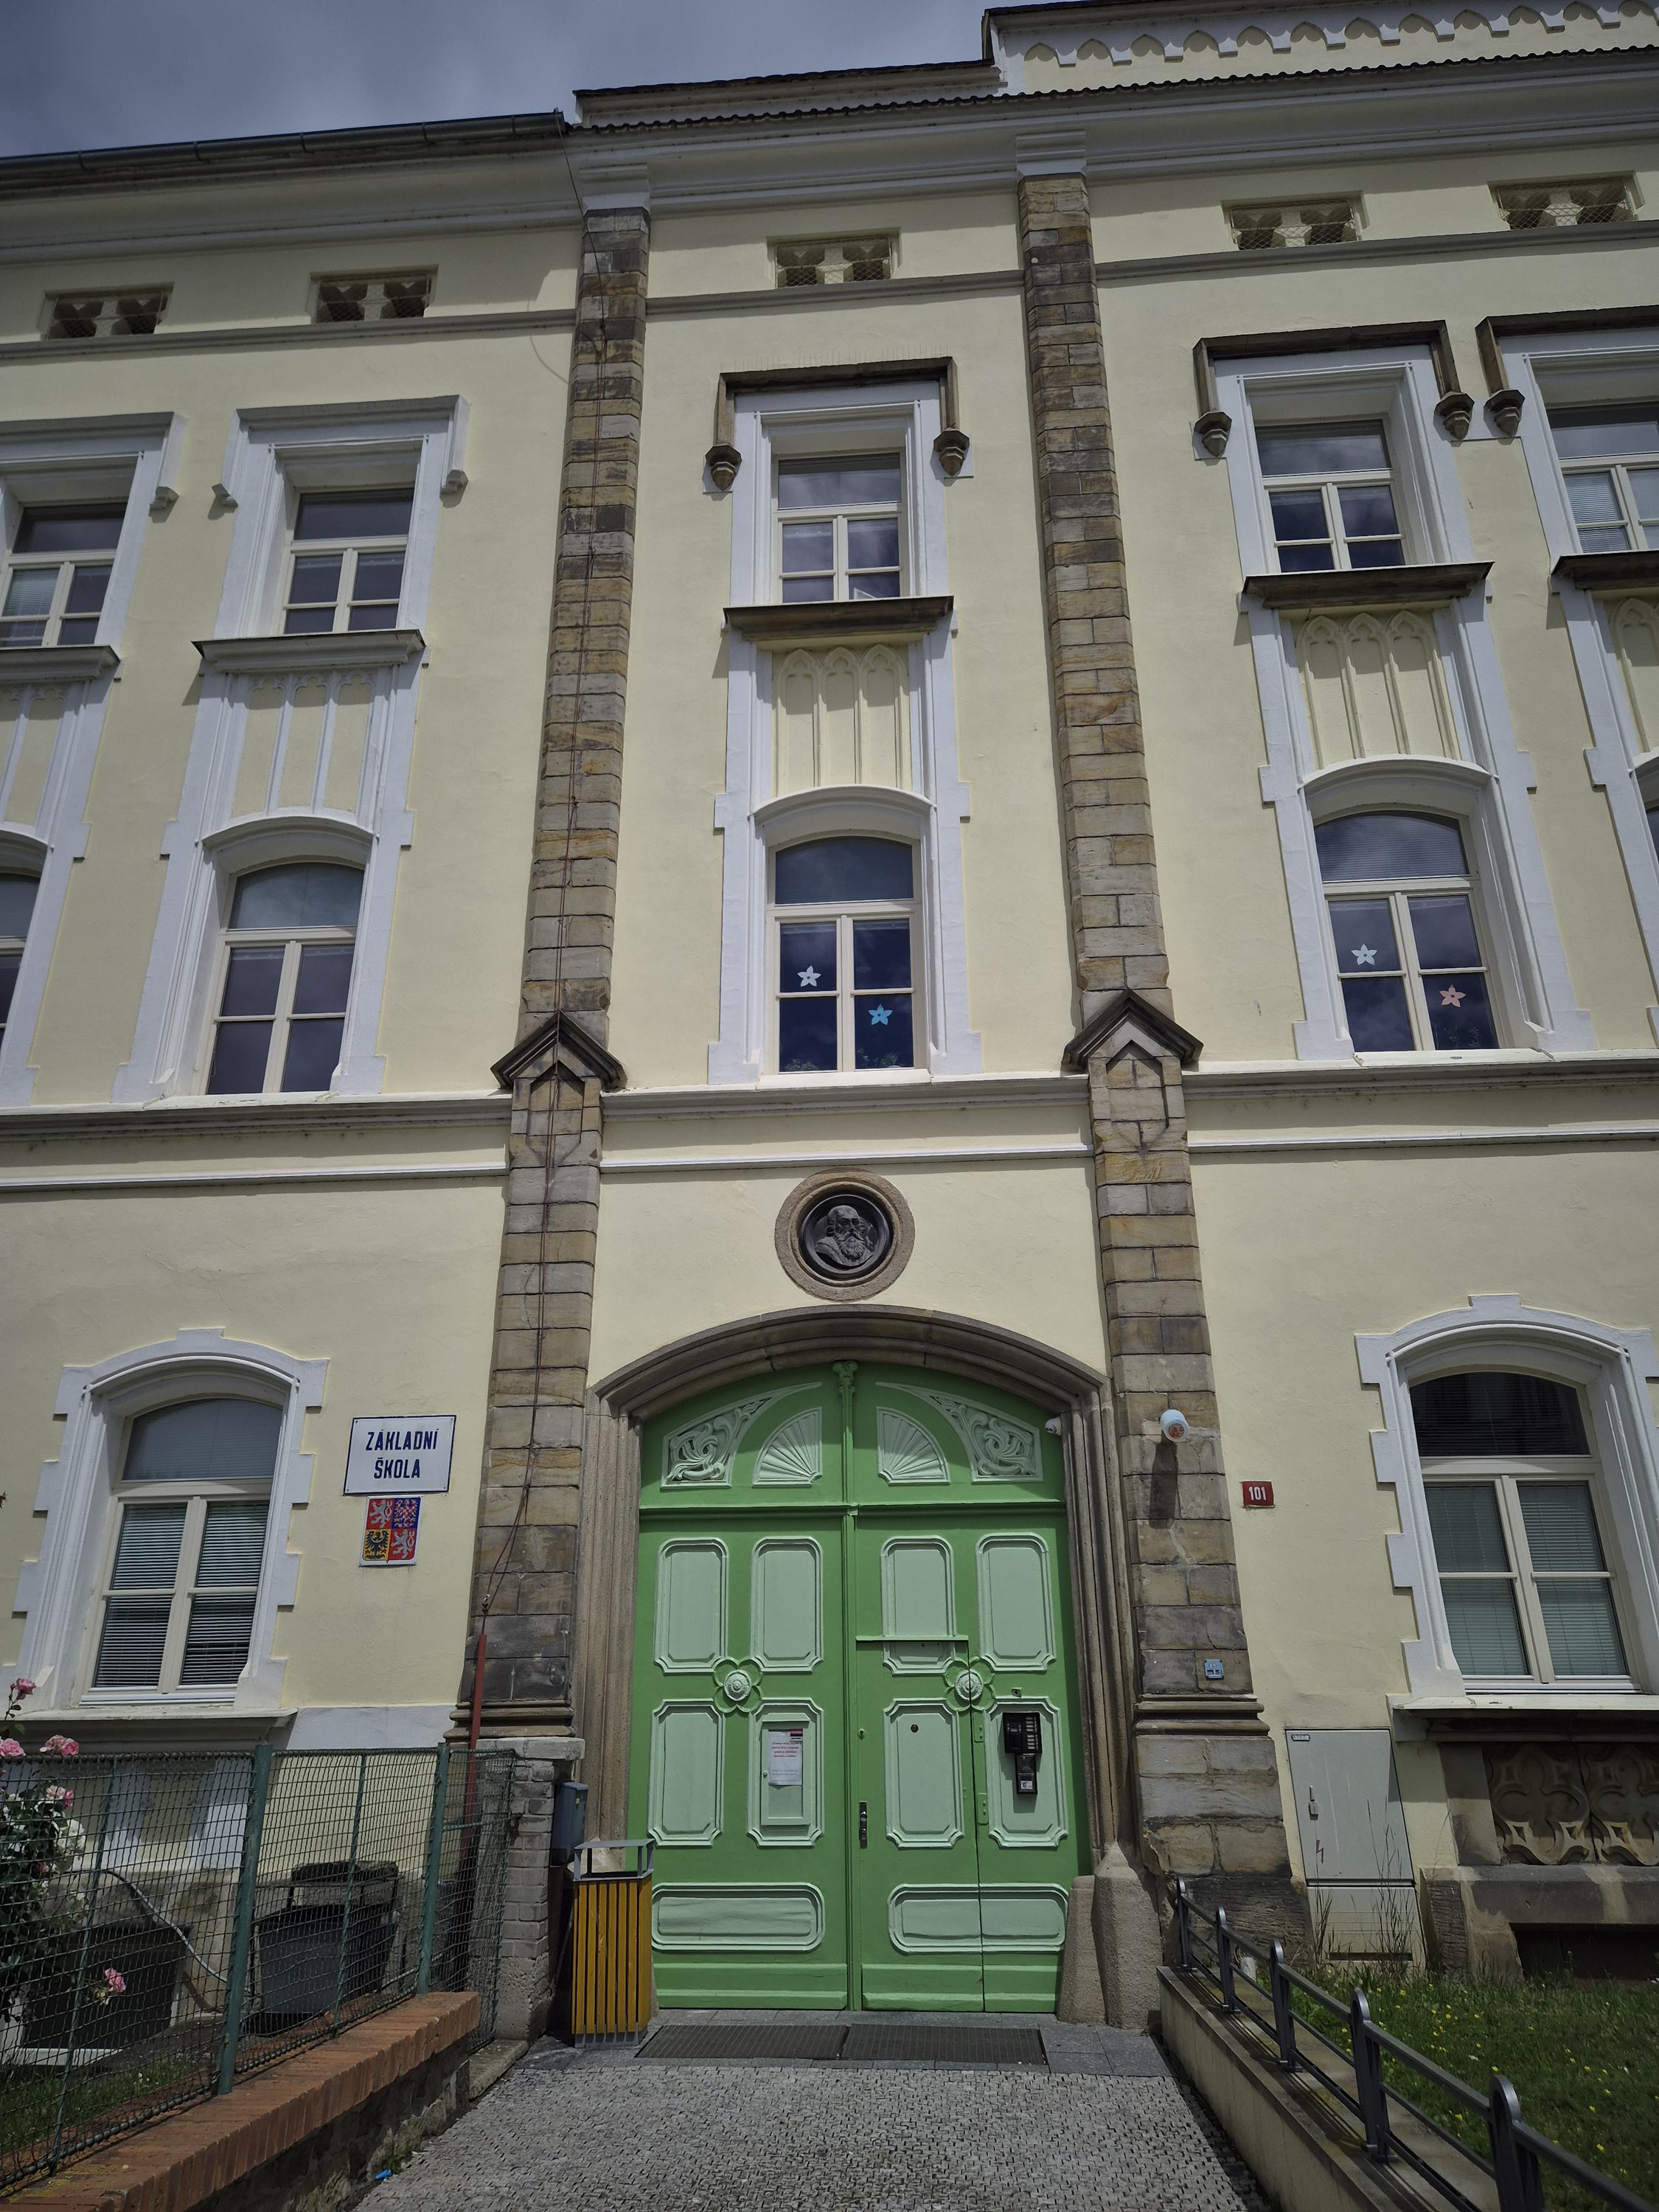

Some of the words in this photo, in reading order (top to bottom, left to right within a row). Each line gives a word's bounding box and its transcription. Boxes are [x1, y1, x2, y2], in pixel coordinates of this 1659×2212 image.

[365, 1428, 439, 1451] ZÁKLADNÍ
[373, 1457, 420, 1479] ŠKOLA
[1248, 1486, 1267, 1500] 101
